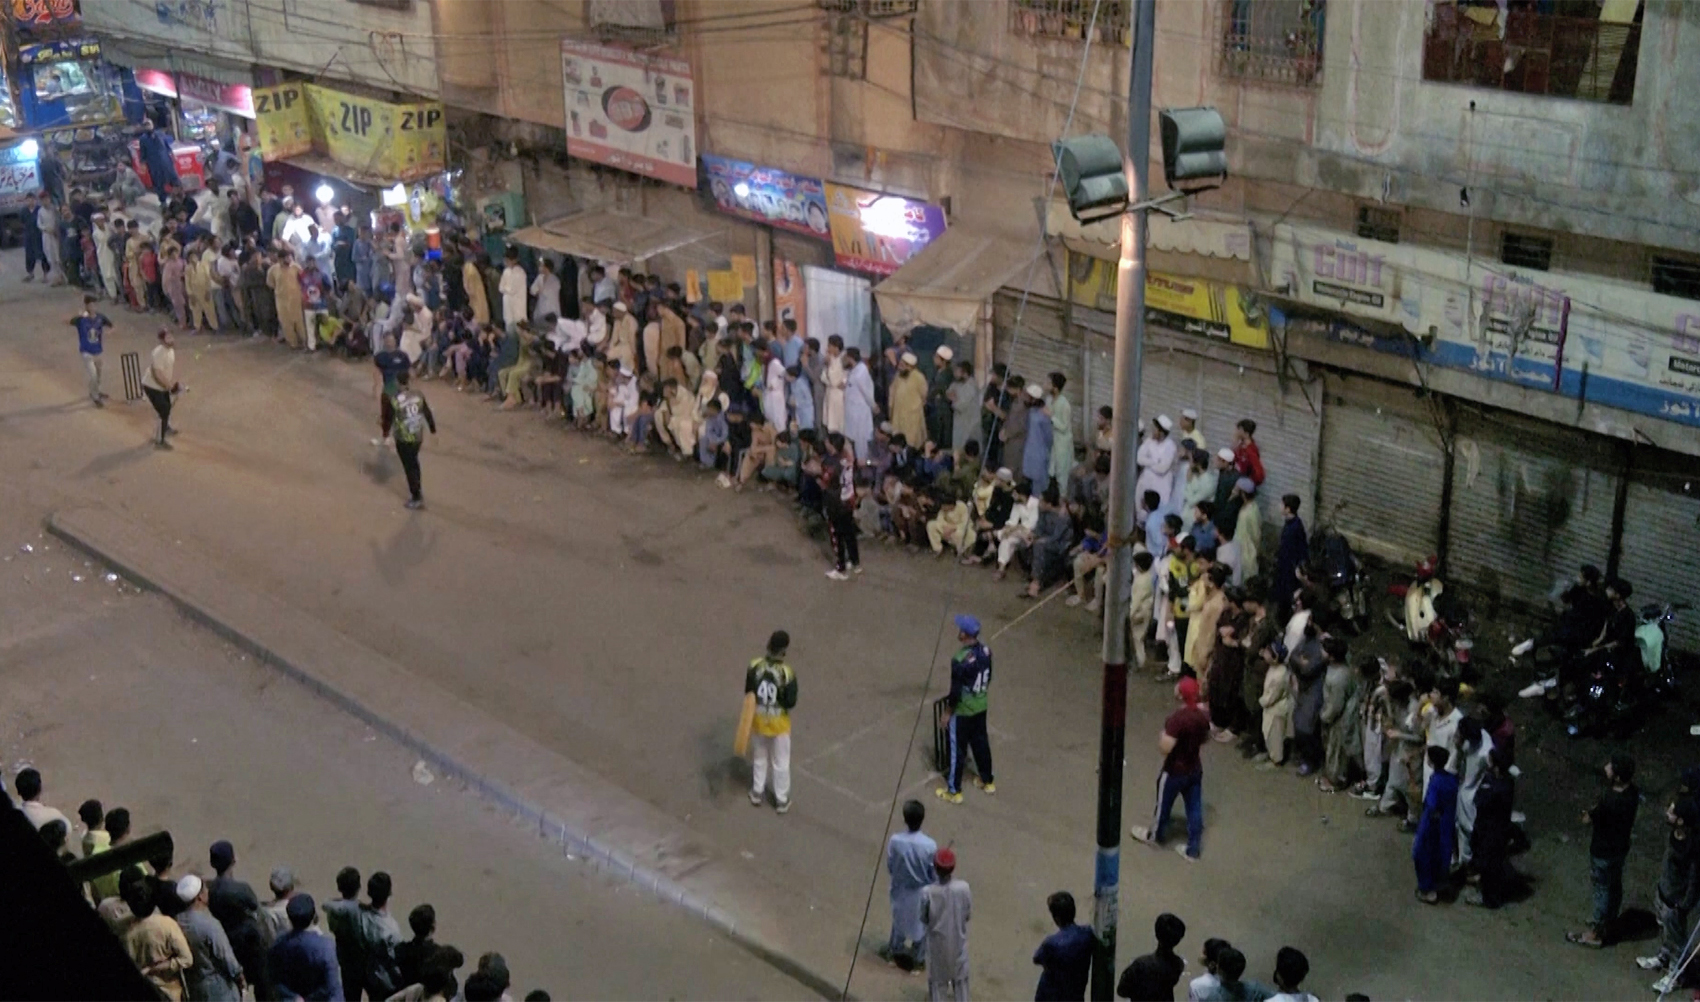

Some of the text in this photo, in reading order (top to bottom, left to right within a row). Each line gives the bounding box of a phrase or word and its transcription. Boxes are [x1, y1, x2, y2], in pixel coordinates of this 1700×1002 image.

[256, 89, 299, 114] ZIP
[340, 101, 372, 137] ZIP
[401, 109, 441, 131] ZIP
[1313, 244, 1386, 288] Gulf
[757, 680, 778, 706] 49
